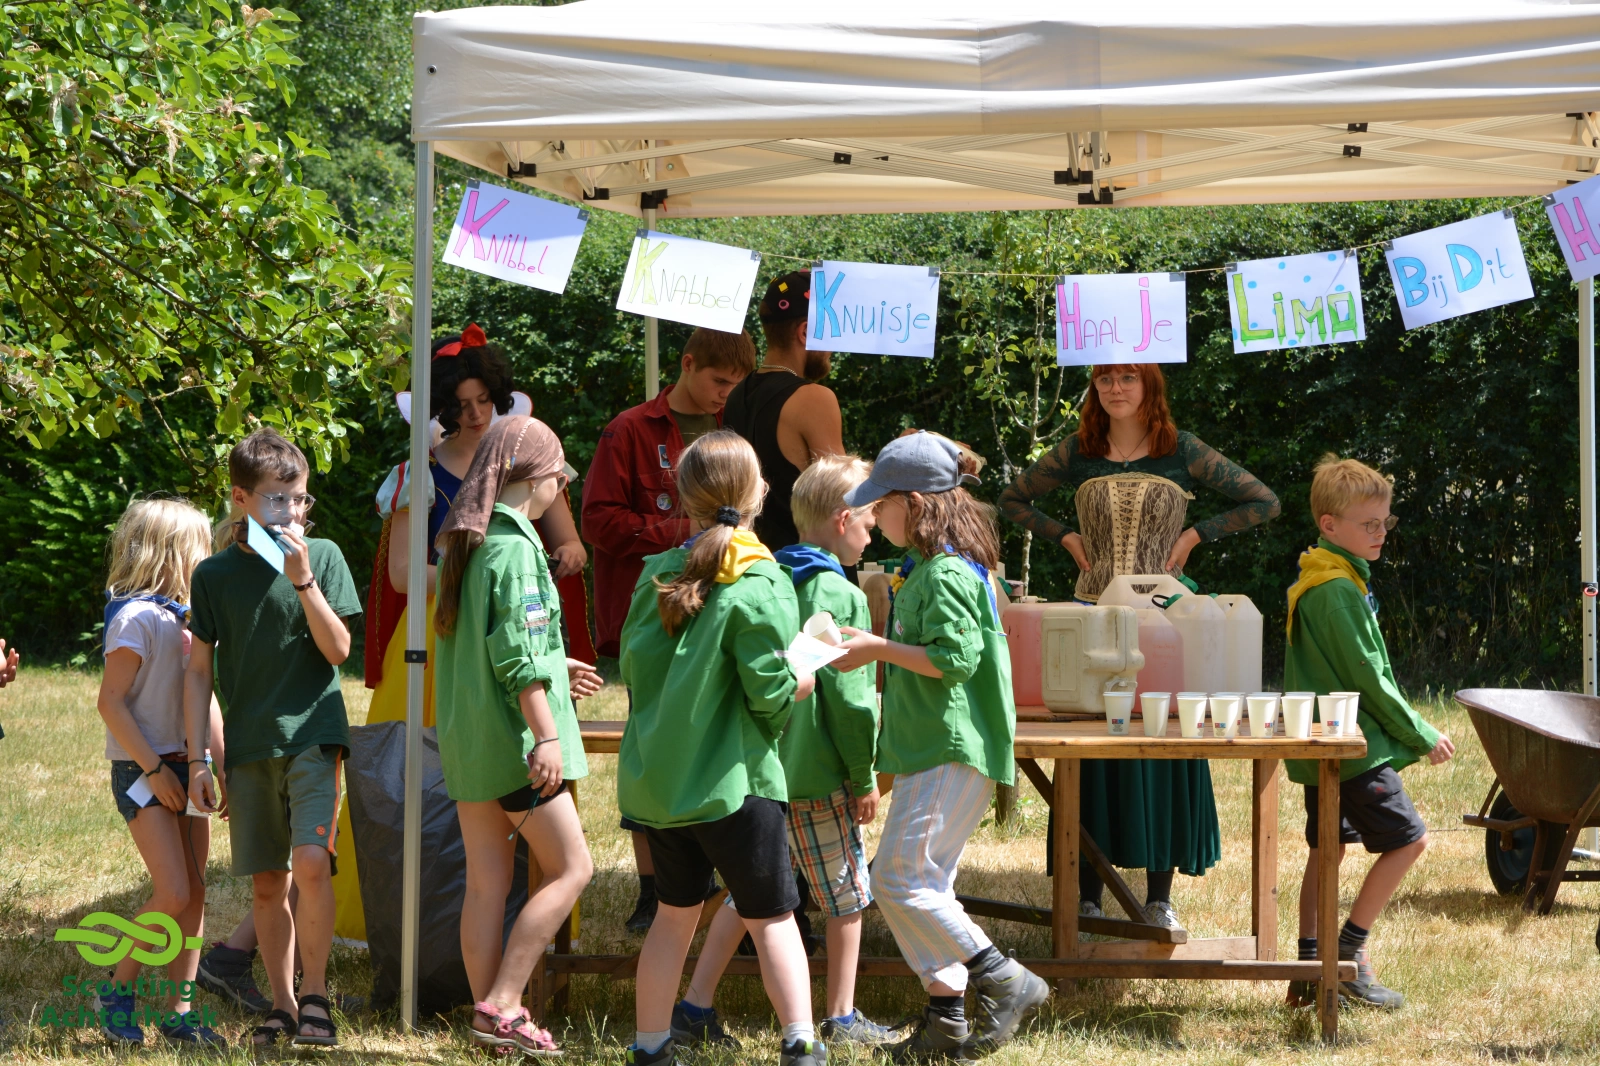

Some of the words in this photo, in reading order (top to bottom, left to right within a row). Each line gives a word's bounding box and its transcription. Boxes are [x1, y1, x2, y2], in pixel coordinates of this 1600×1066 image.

[1553, 196, 1600, 263] H
[1392, 256, 1448, 309] Bij
[1446, 243, 1514, 294] Dit
